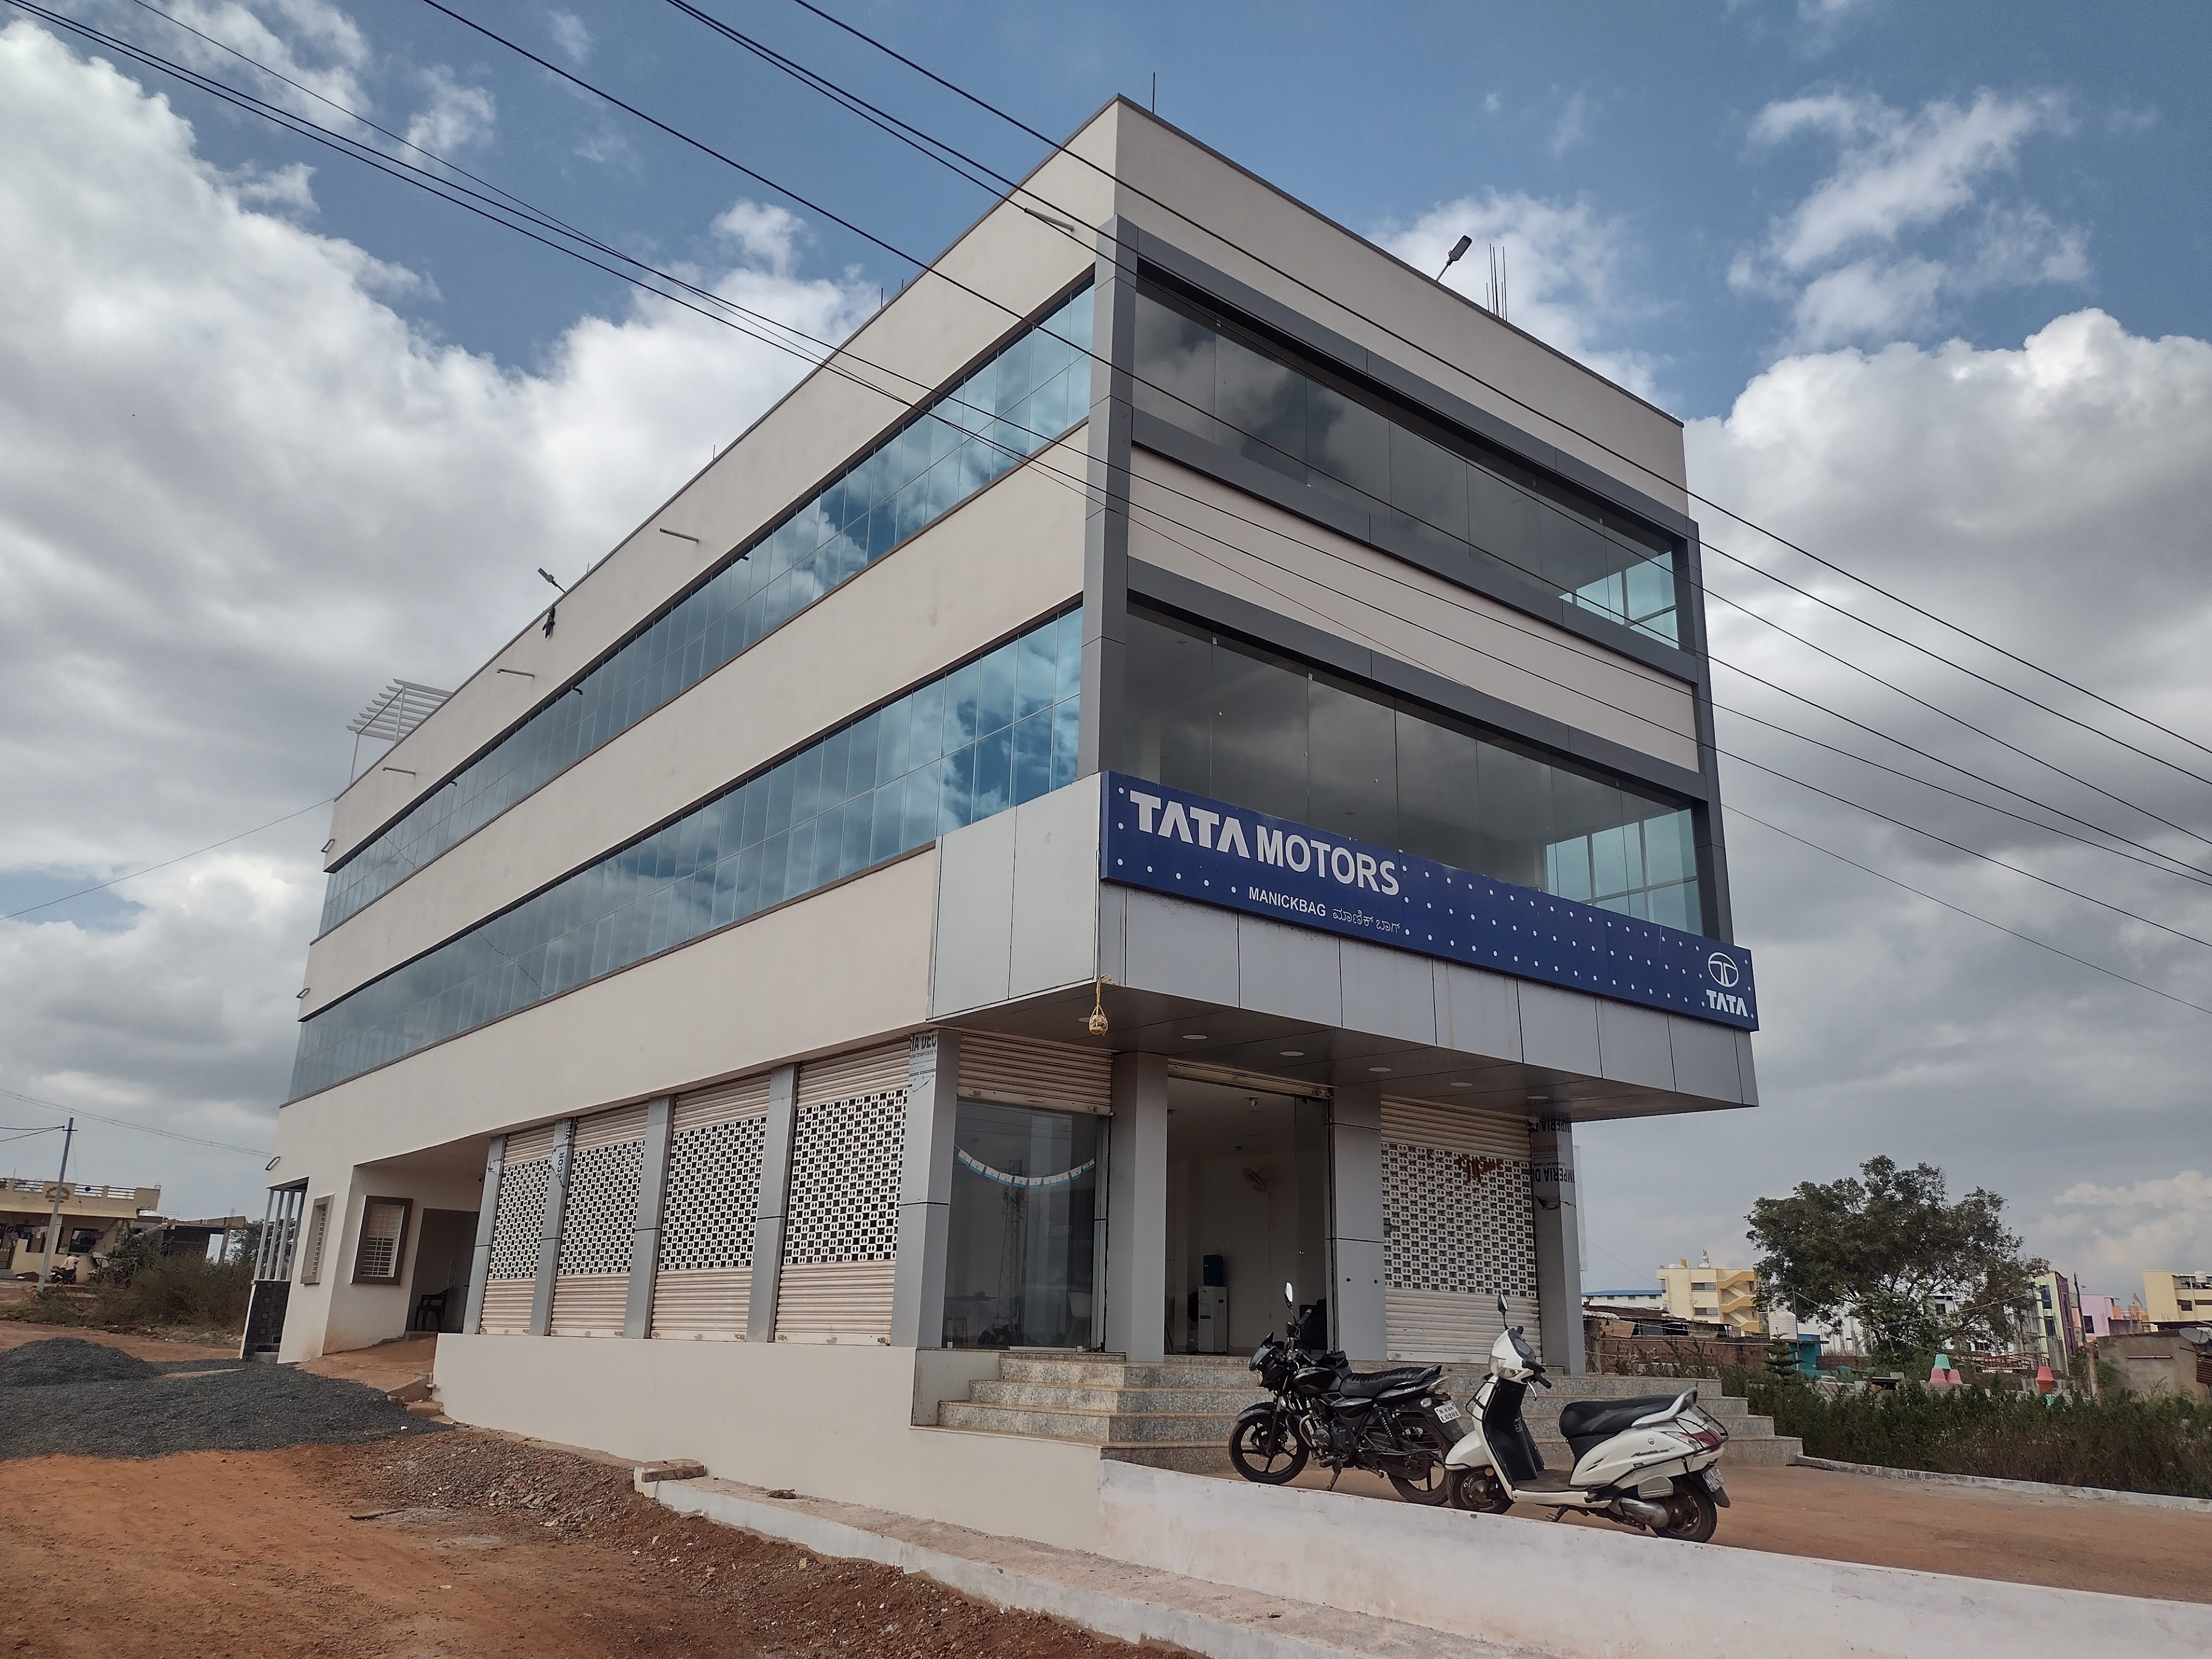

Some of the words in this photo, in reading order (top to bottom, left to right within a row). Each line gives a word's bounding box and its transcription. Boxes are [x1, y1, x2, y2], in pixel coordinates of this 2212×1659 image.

[1130, 790, 1251, 859] TATA
[1256, 824, 1400, 896] MOTORS
[1248, 886, 1326, 917] MANICKBAG
[1706, 988, 1748, 1017] TATA
[1543, 1168, 1575, 1184] IMPERIA
